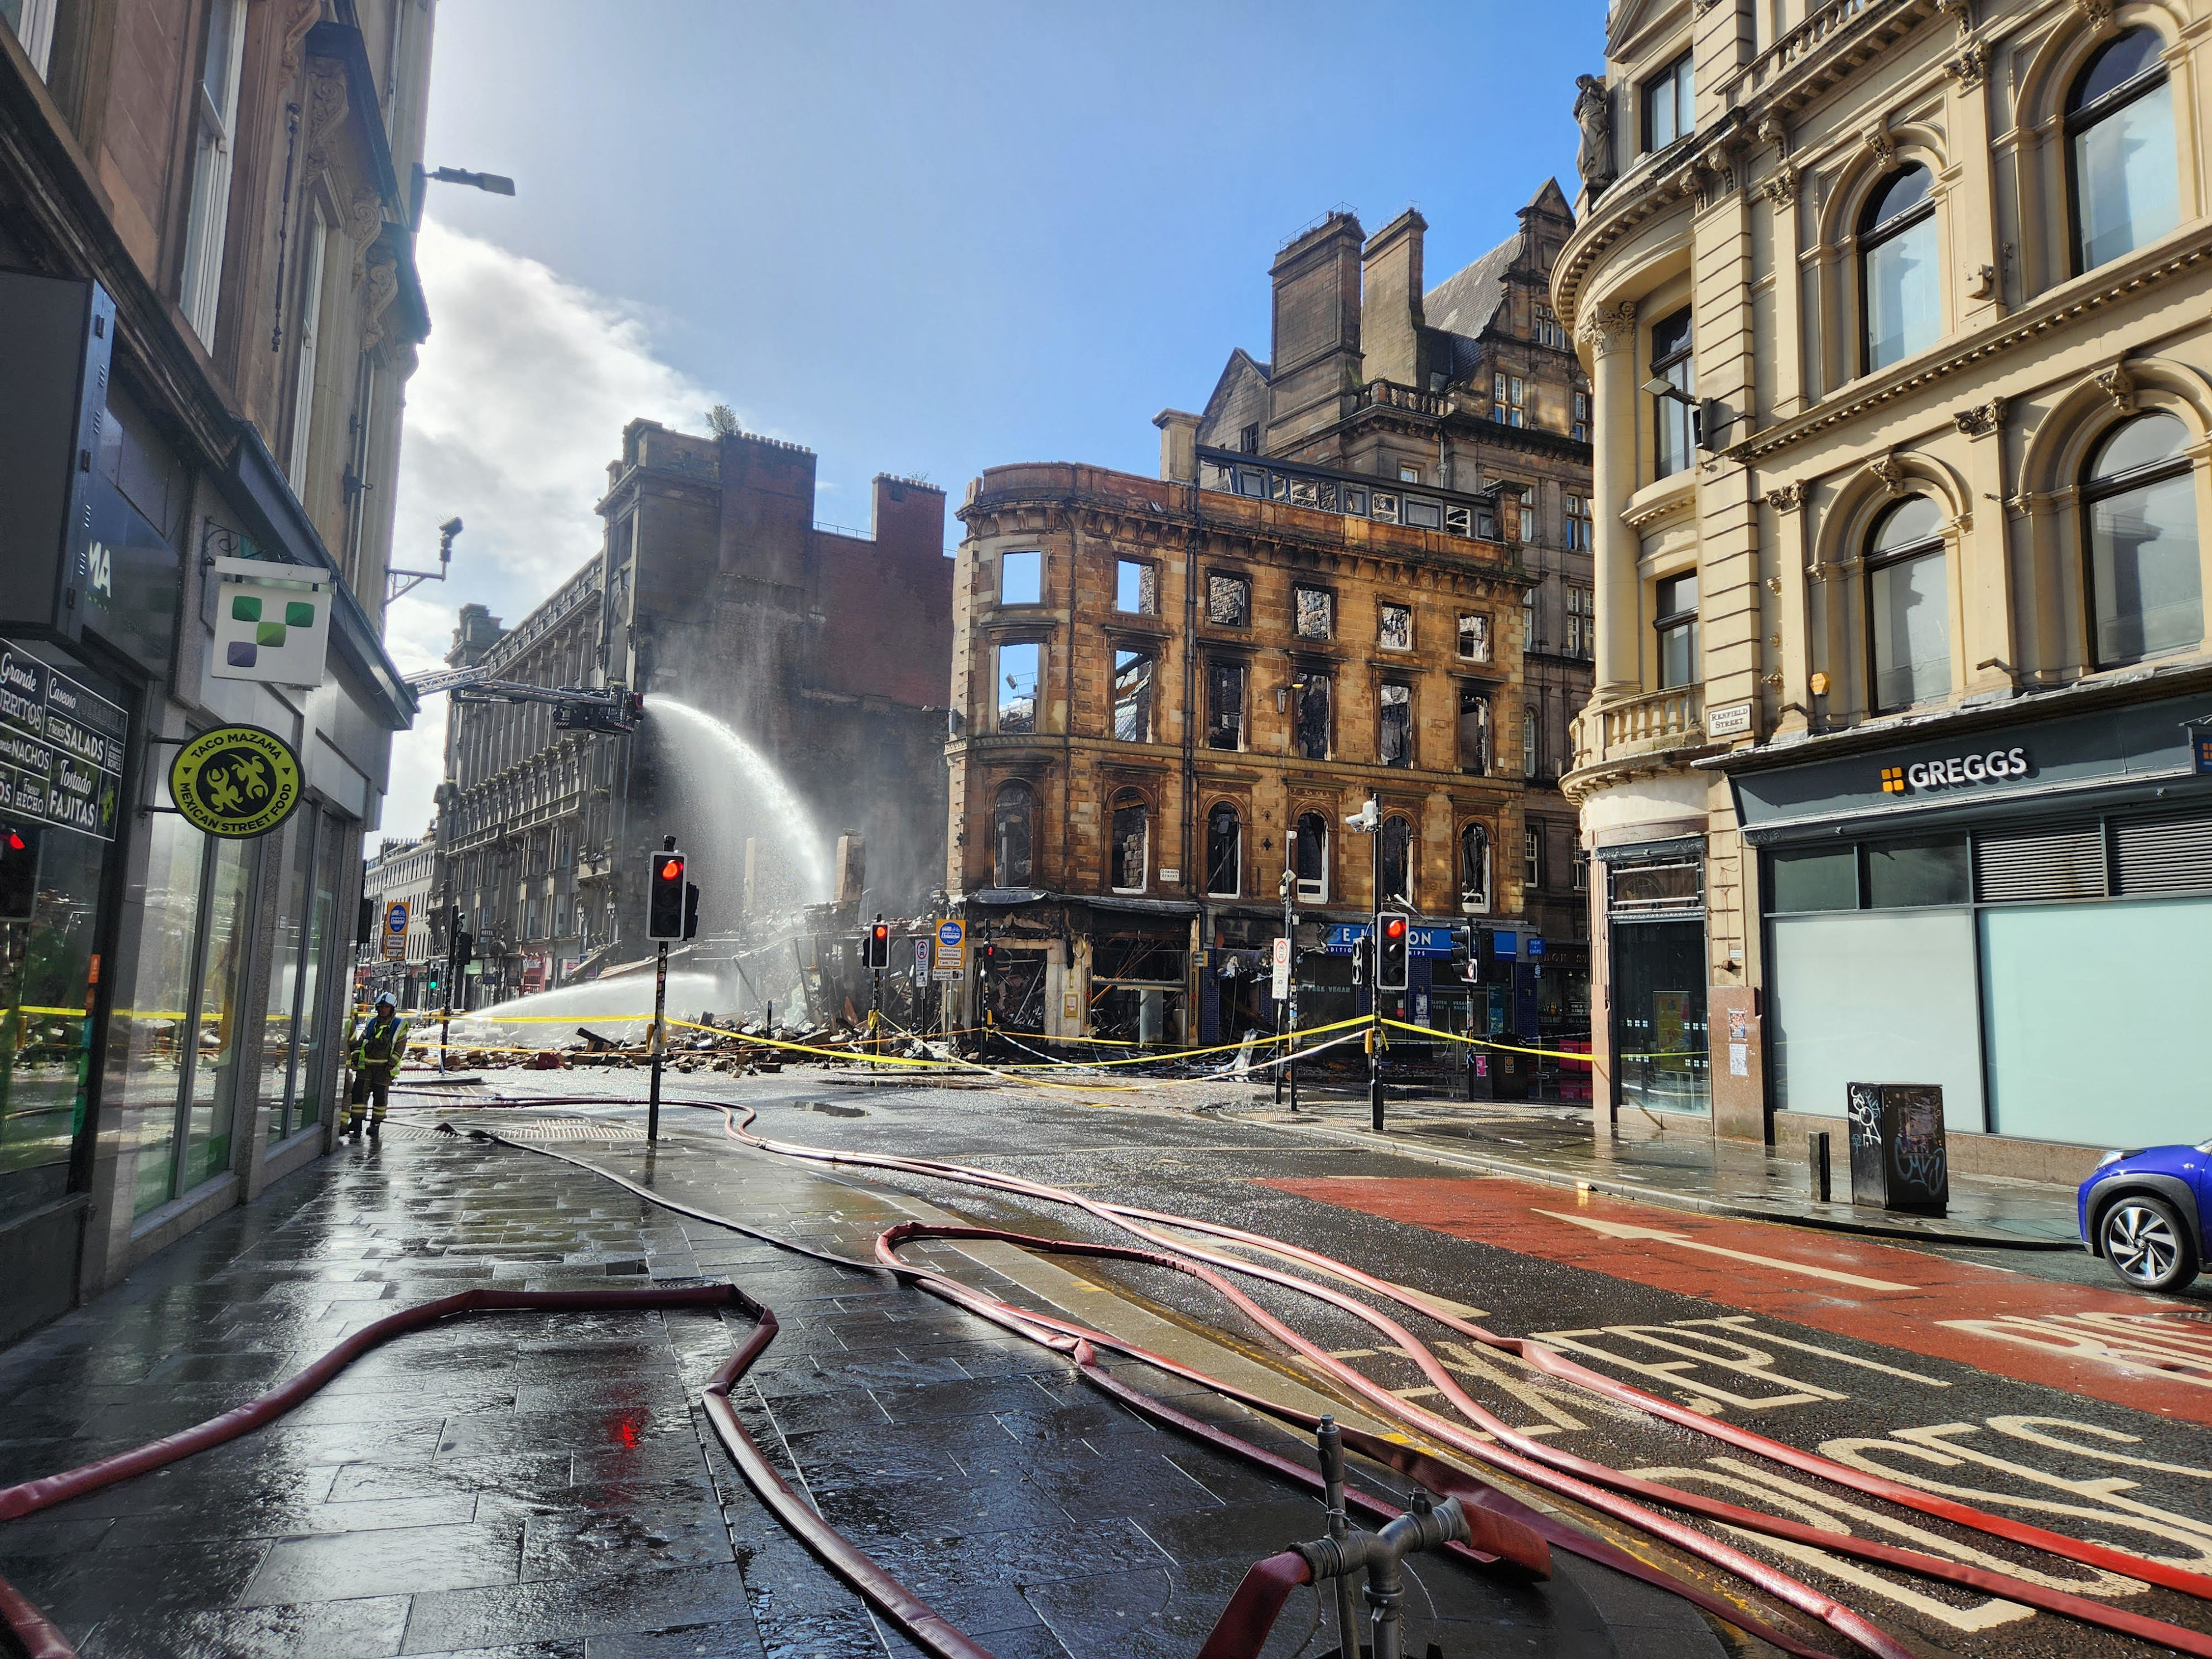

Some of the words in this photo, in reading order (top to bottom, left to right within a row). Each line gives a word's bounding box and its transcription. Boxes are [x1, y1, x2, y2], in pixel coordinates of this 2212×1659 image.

[0, 652, 37, 692] Grande
[1711, 708, 1748, 721] RENFIELD
[1715, 717, 1744, 729] STREET
[12, 739, 50, 770] NACHOS
[64, 724, 104, 761] SALADS
[190, 736, 224, 759] TACO
[227, 733, 283, 760] MAZAMA
[60, 759, 92, 795] Tostado
[1907, 747, 2027, 788] GREGGS
[16, 792, 44, 813] HECHO
[49, 790, 95, 827] FAJITAS
[180, 783, 220, 828] MEXICAN
[221, 814, 272, 832] STREET
[270, 783, 292, 816] FOOD
